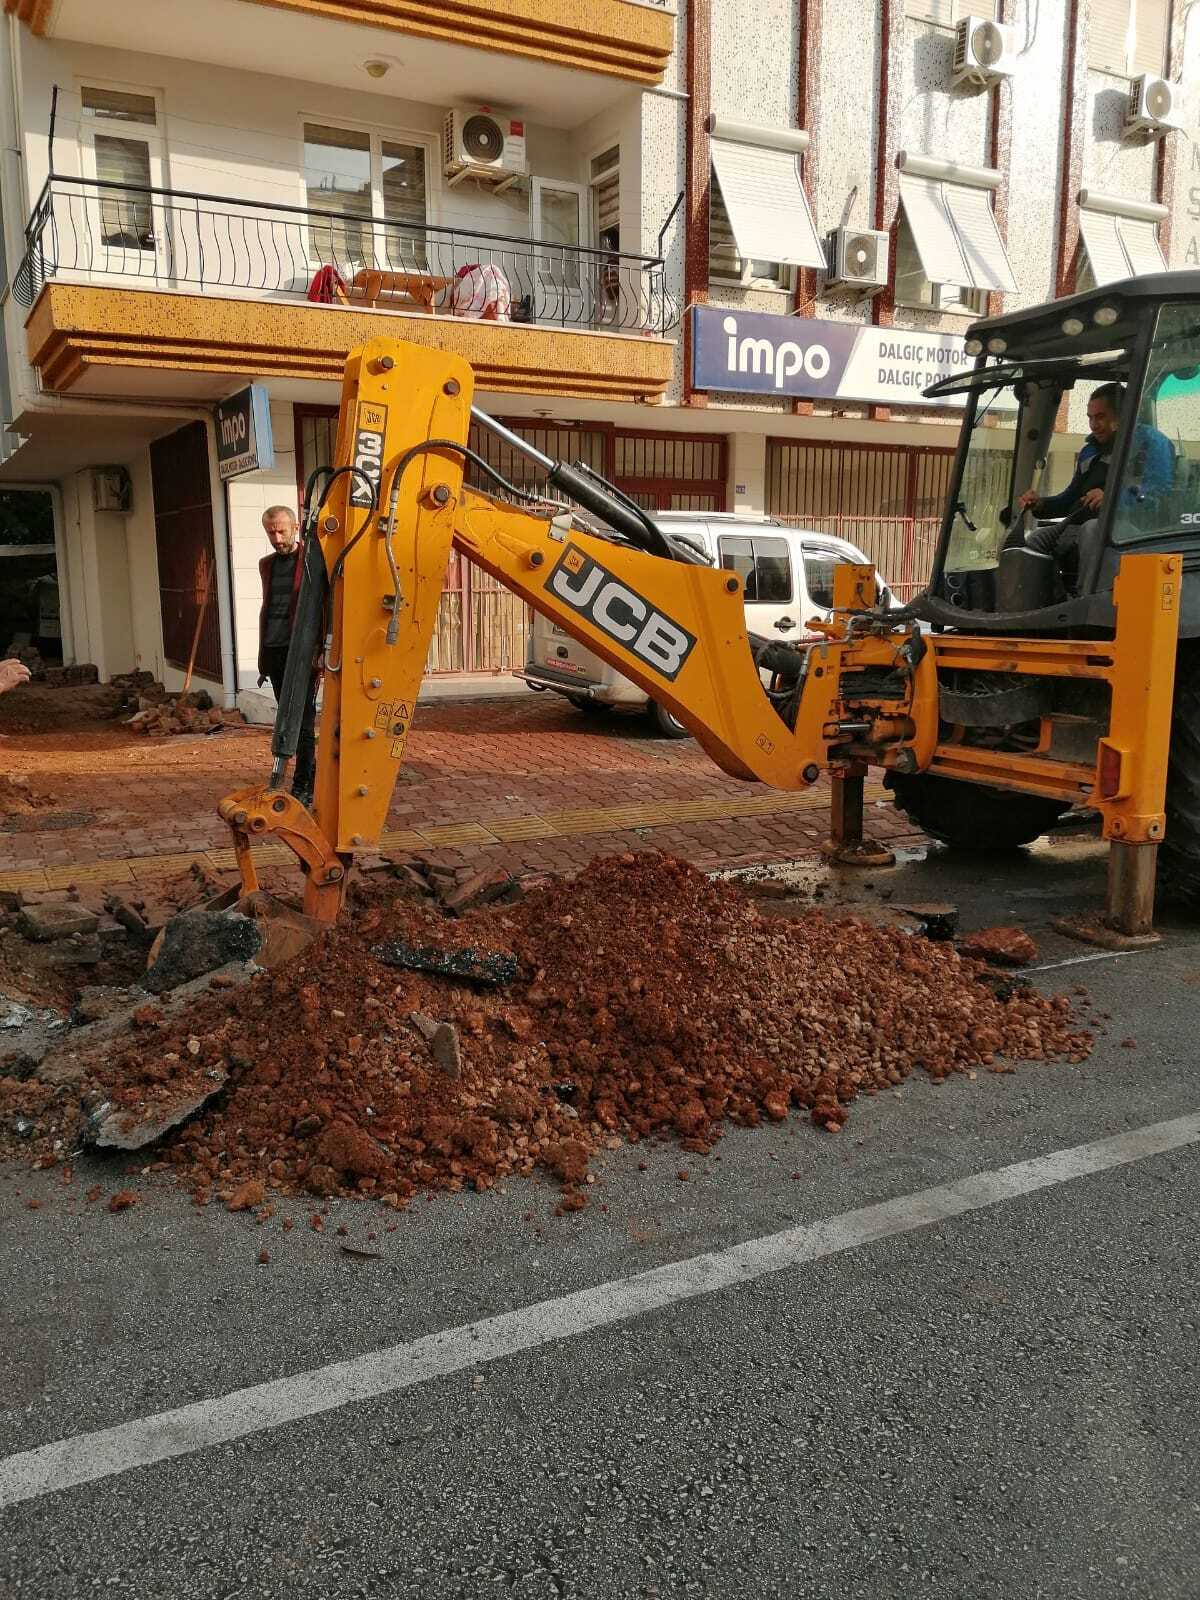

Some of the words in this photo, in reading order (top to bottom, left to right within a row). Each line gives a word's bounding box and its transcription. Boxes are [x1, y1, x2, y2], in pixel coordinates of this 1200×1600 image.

[723, 316, 831, 388] impo
[879, 342, 924, 364] DALGIÇ
[926, 347, 967, 366] MOTOR
[878, 368, 923, 390] DALGIÇ
[218, 407, 246, 452] impo
[552, 566, 689, 673] JCB
